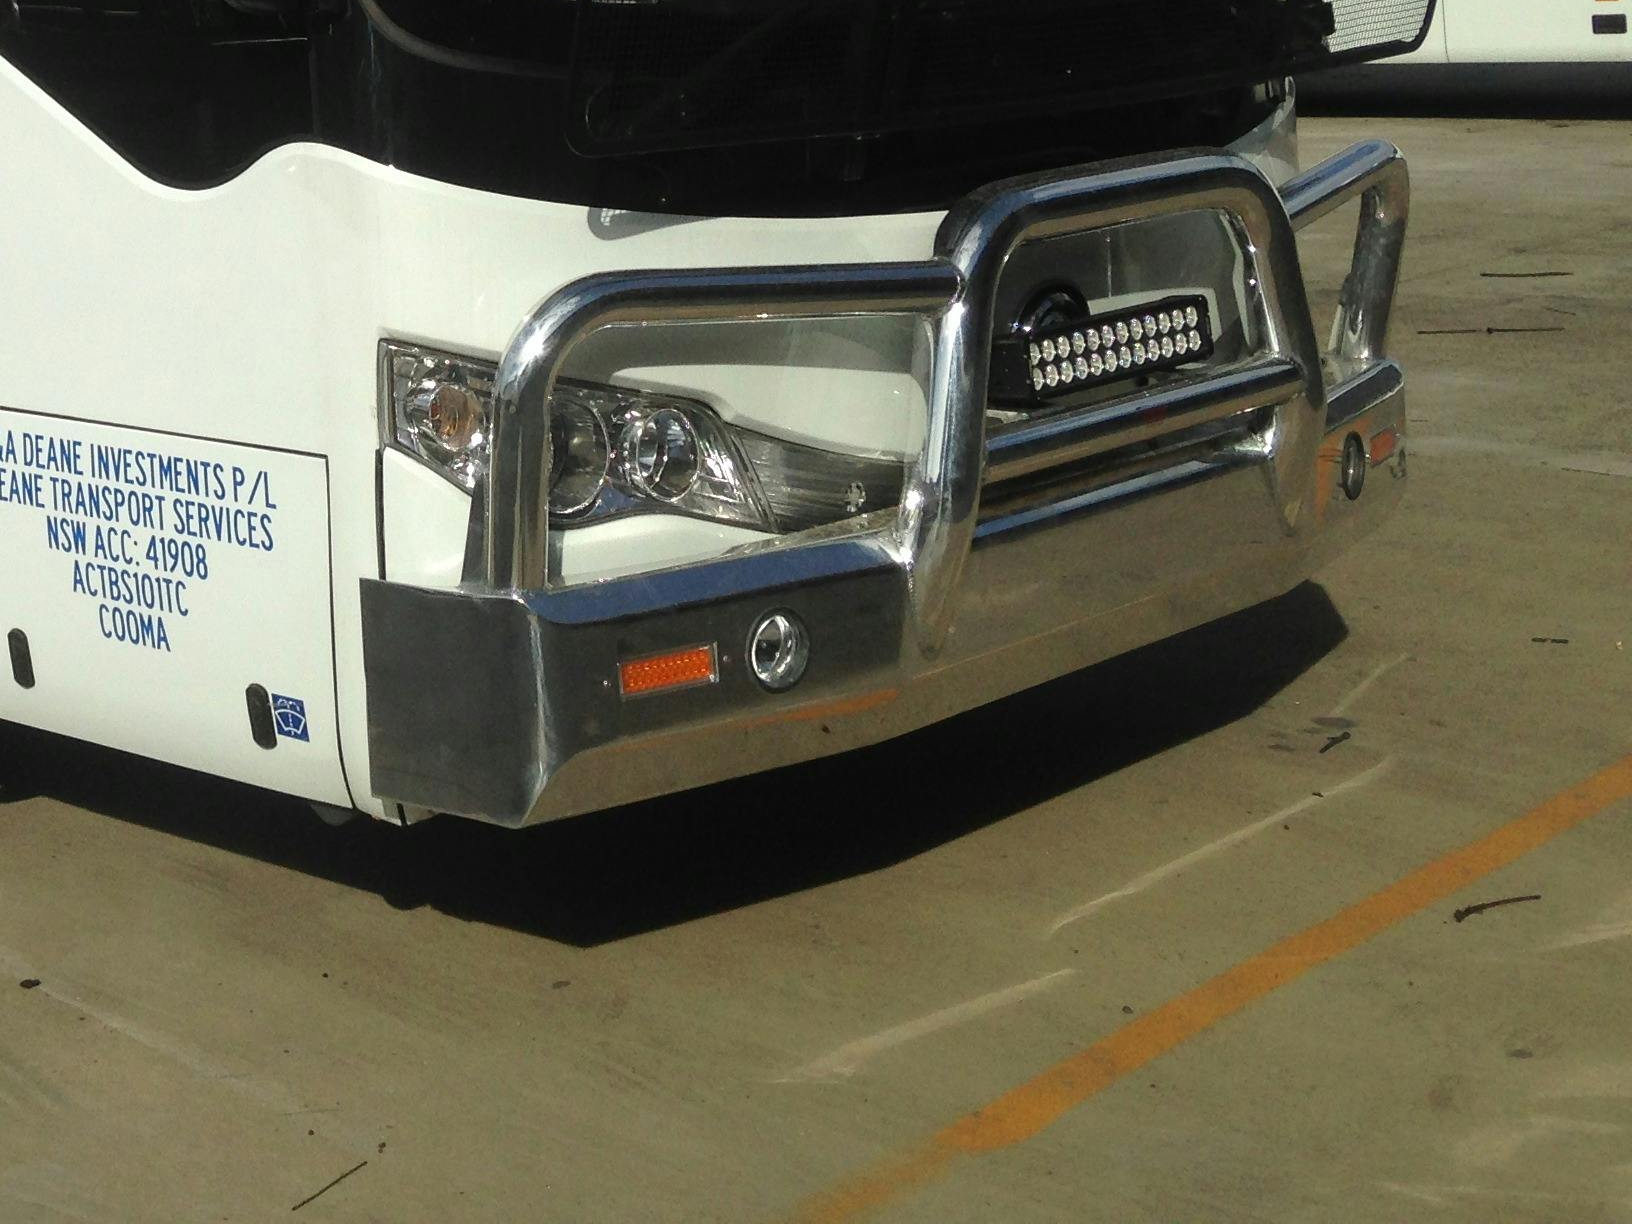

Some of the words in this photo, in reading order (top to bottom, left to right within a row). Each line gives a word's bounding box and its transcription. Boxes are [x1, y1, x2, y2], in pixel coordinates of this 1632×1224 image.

[23, 432, 83, 476] DEANE
[90, 443, 226, 501] INVESTMENTS
[50, 477, 165, 531] TRANSPORT
[173, 498, 274, 552] SERVICES
[46, 515, 86, 556] NSW
[94, 525, 140, 566] ACC:
[145, 535, 208, 581] 41908
[73, 560, 188, 617] ACTBS101TC
[99, 604, 171, 652] COOMA
